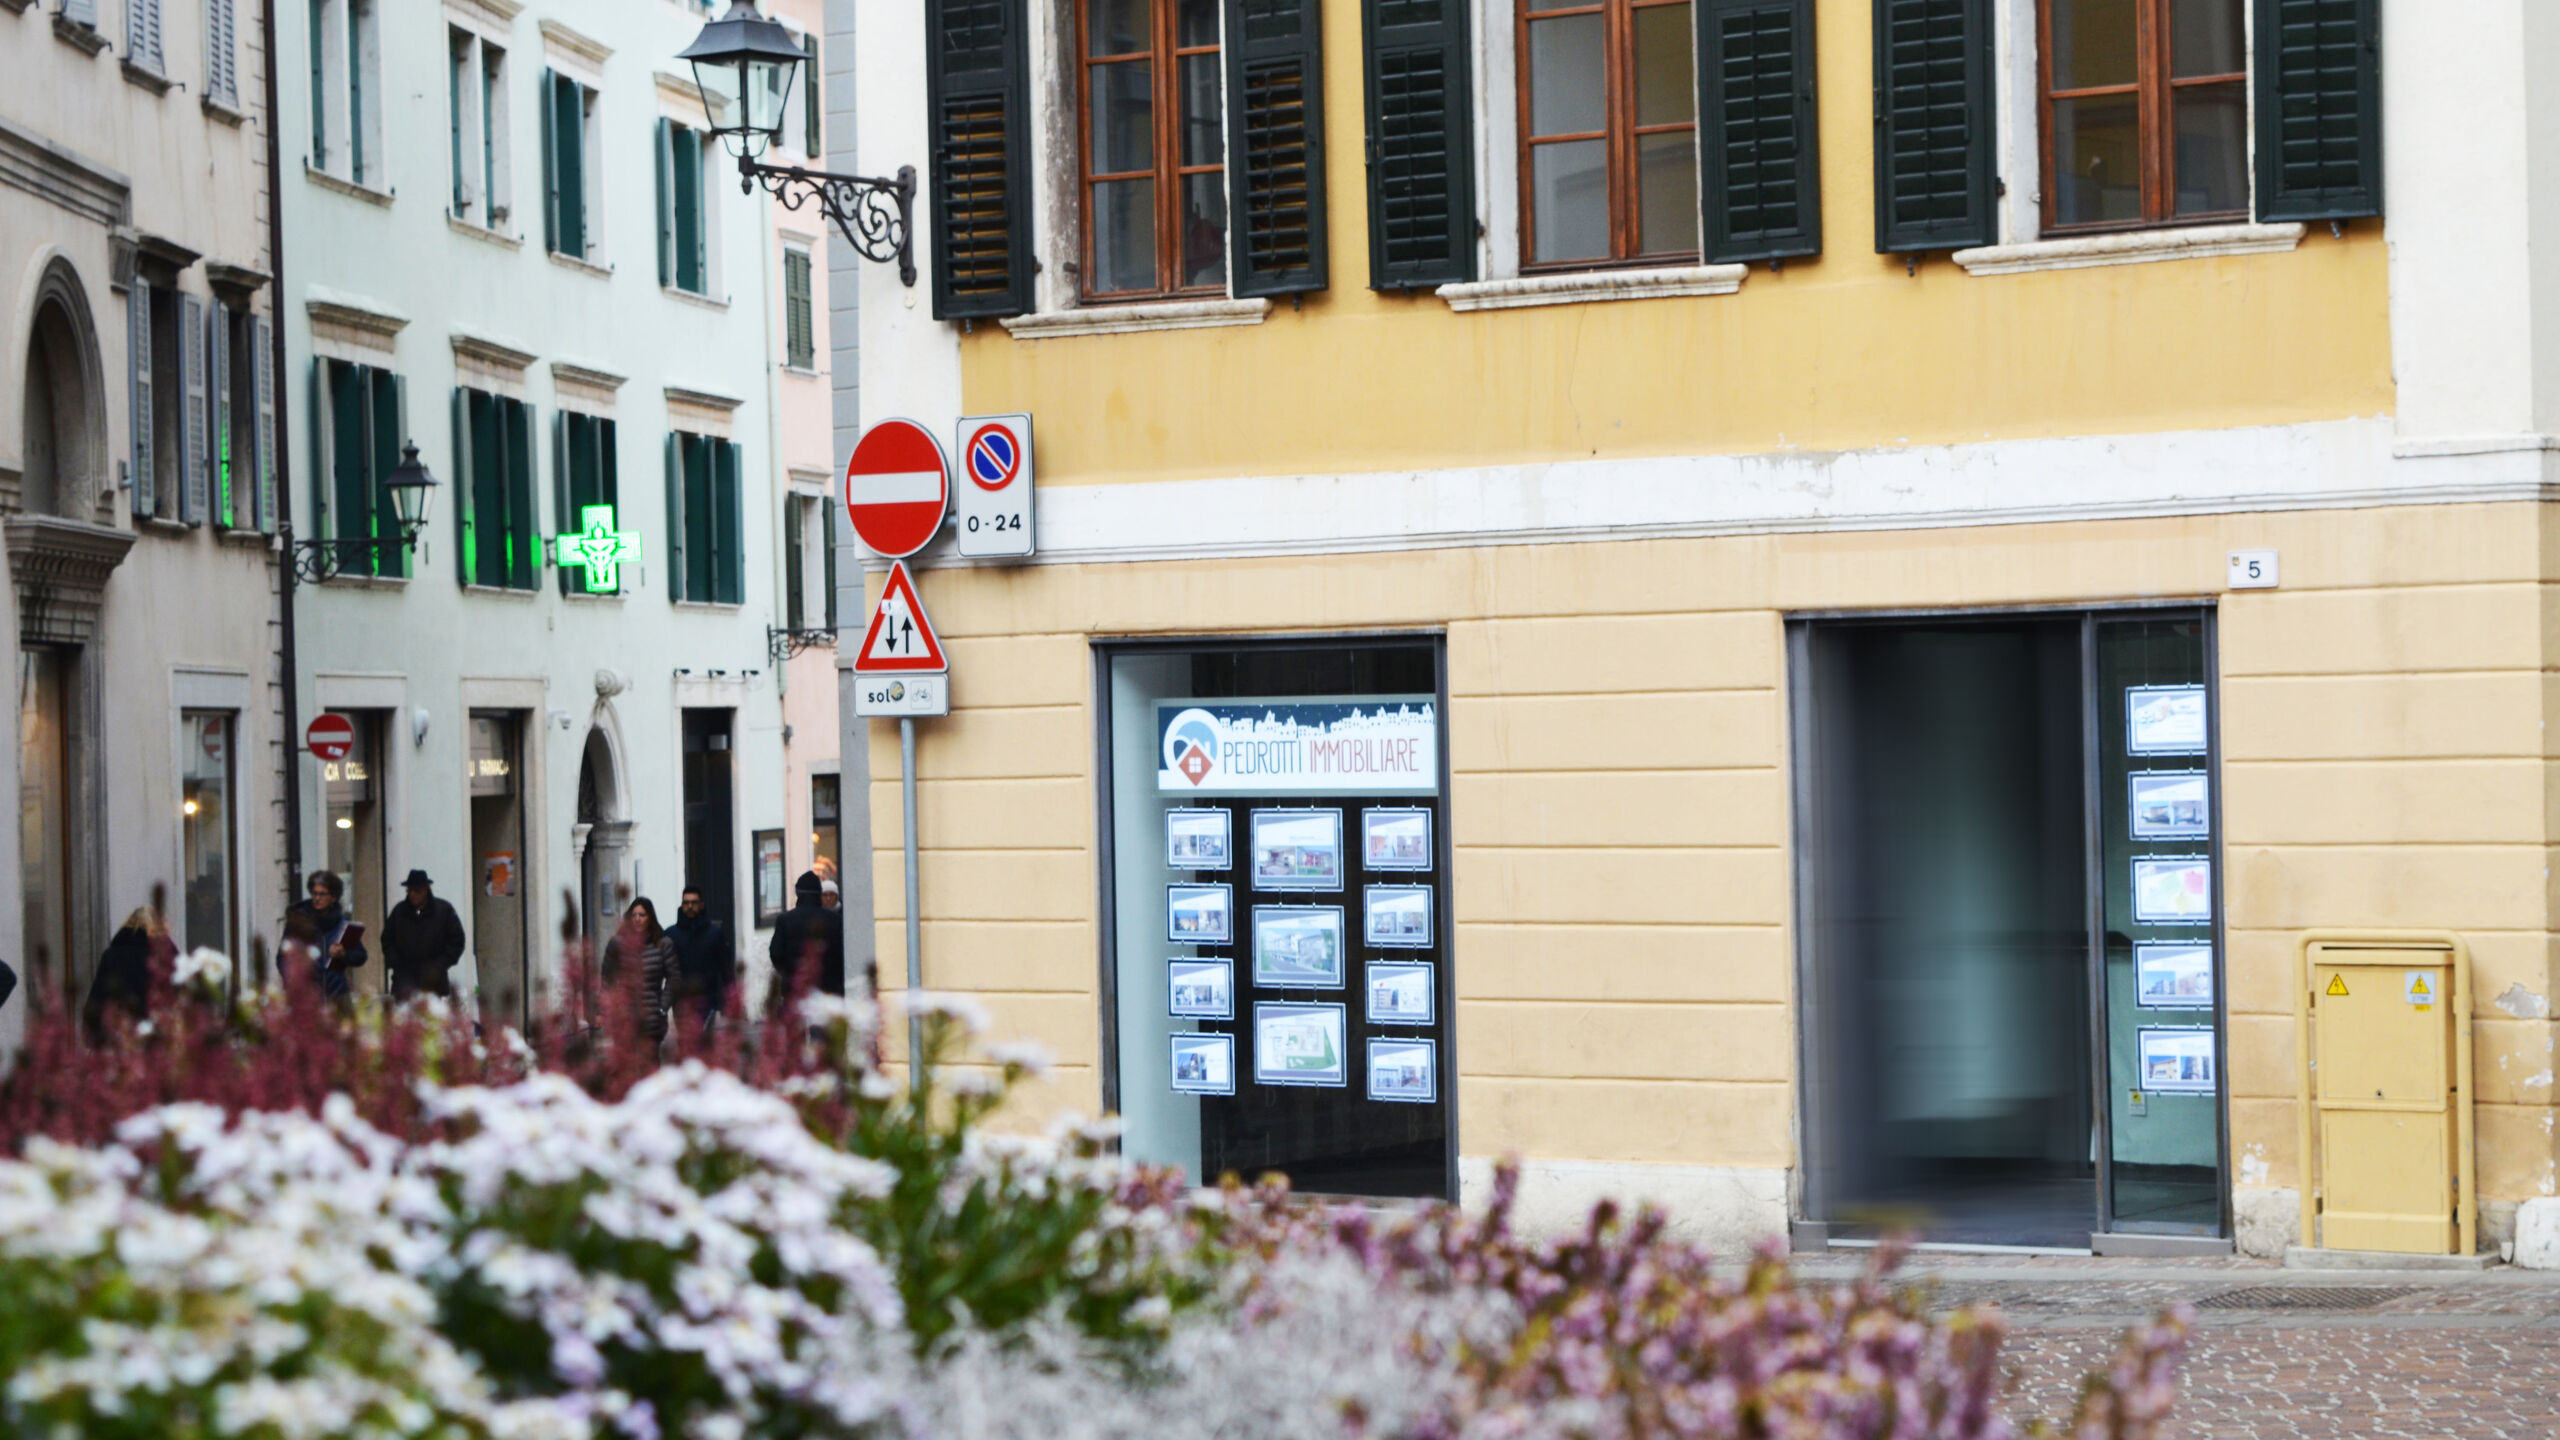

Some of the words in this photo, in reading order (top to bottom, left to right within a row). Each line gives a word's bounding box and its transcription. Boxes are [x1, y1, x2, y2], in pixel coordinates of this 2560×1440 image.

[2248, 560, 2261, 579] 5
[1223, 740, 1302, 774] PEDROTTI
[1310, 738, 1419, 773] IMMOBILIARE
